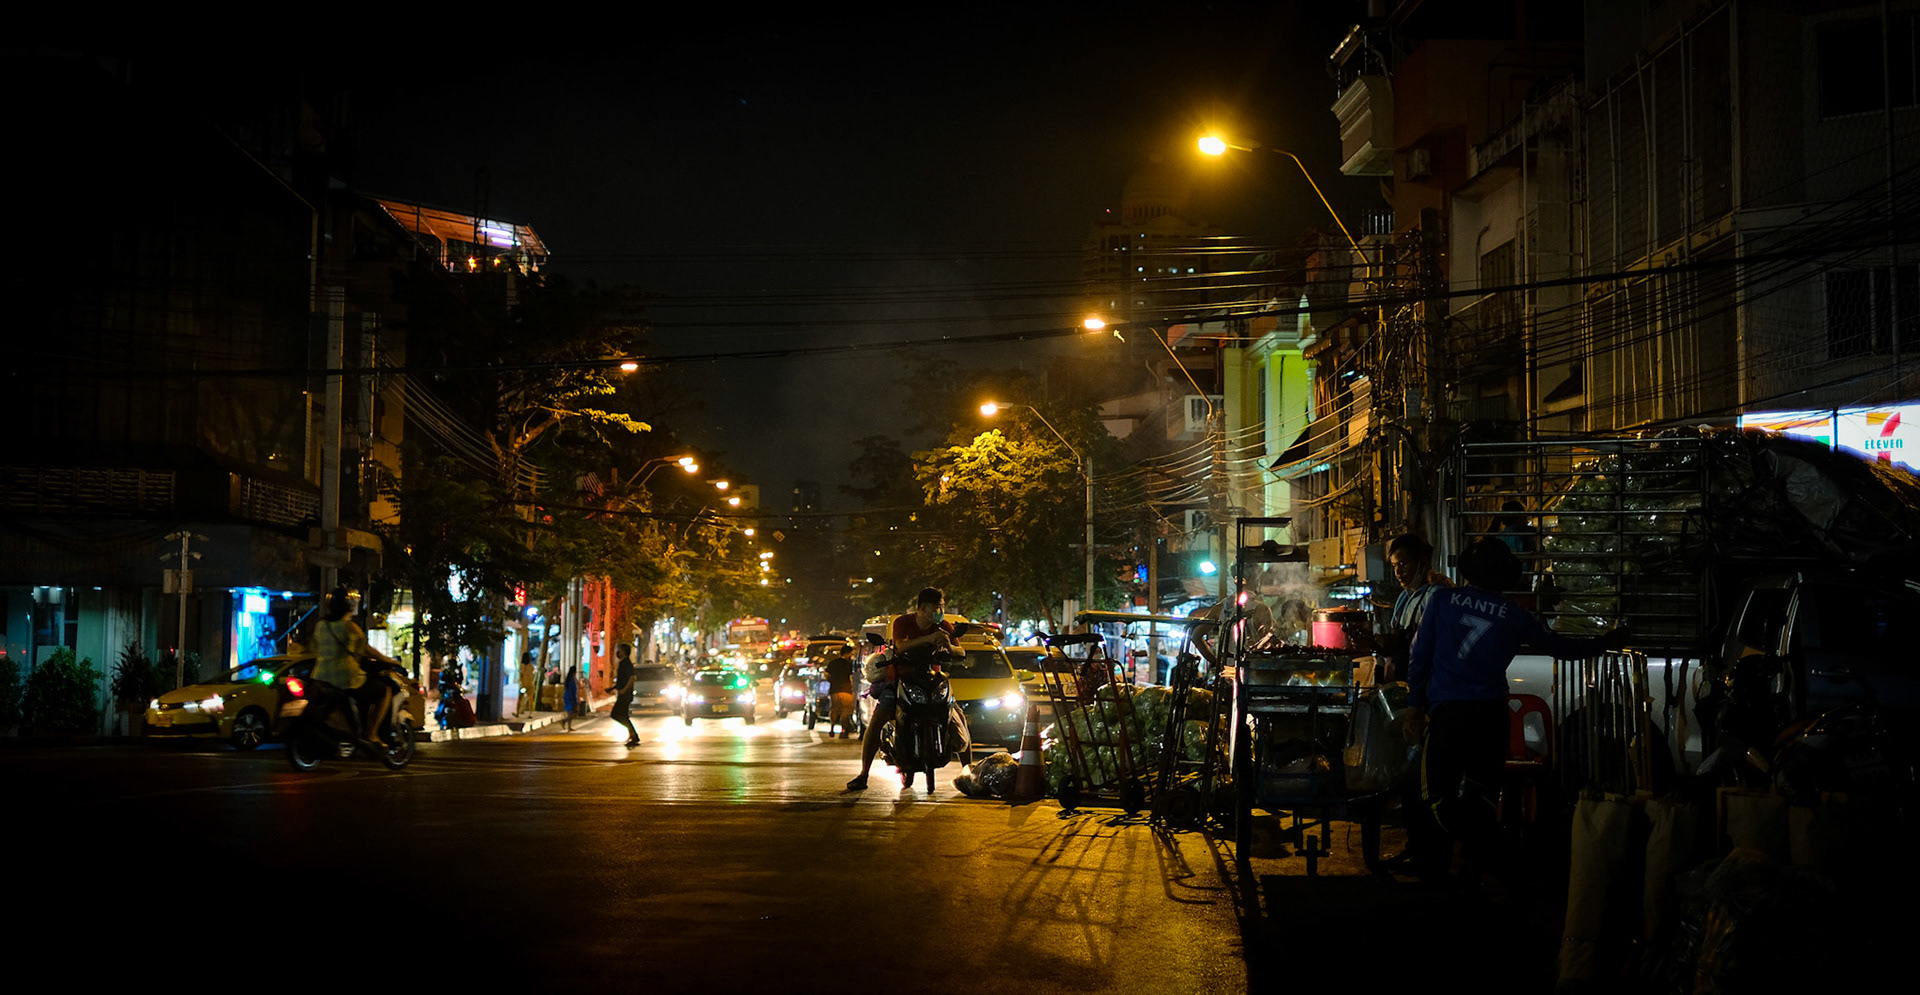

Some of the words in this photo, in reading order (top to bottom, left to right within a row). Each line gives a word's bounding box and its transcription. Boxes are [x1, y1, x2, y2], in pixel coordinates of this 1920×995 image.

[1866, 411, 1901, 463] 7
[1450, 593, 1508, 619] KANTÉ
[1457, 613, 1493, 659] 7
